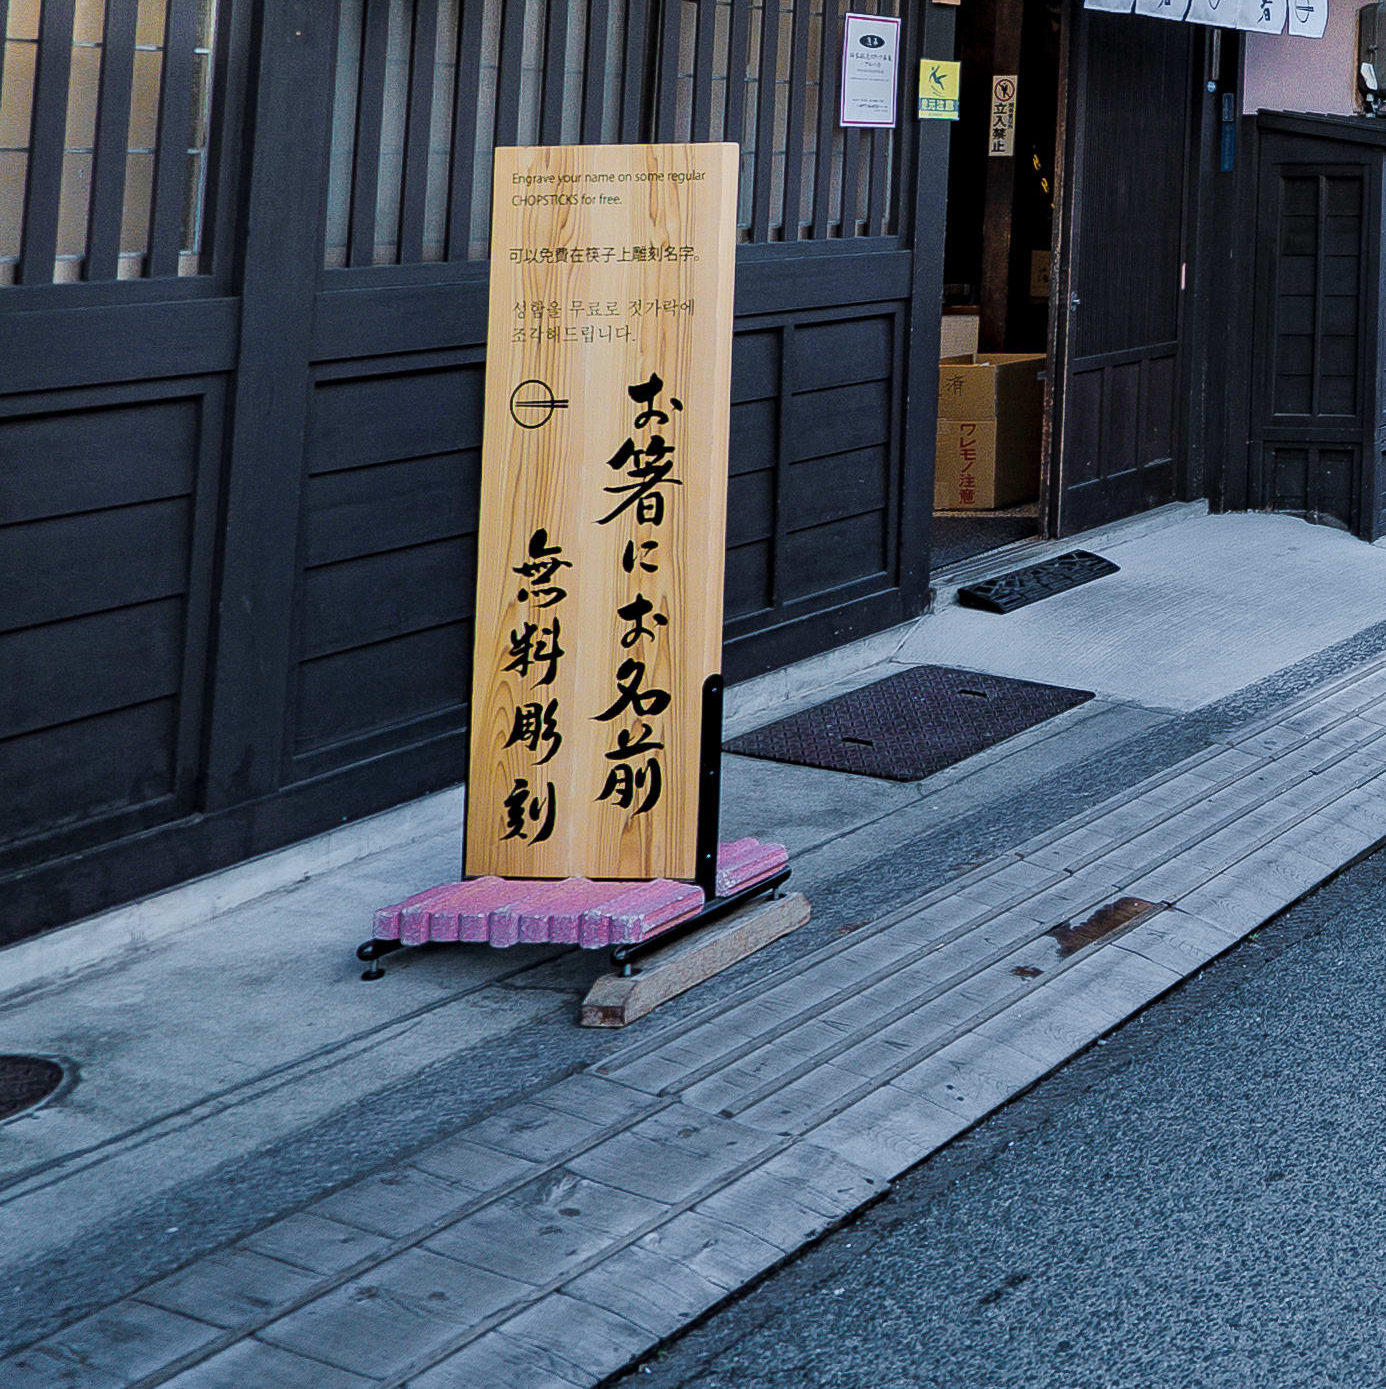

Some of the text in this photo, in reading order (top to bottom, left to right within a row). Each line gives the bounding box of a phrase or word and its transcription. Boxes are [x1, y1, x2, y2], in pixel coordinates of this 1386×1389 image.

[991, 101, 1007, 152] 立入禁止
[512, 170, 706, 186] Engrave your name on some regular
[512, 193, 622, 206] CHOPSTICKS for free.
[512, 298, 695, 318] 성함을 무료로 젓가락에
[511, 325, 637, 343] 조각해드립니다.
[959, 423, 977, 504] ワレモノ注意
[589, 372, 684, 818] お箸にお名前
[499, 528, 573, 847] 無料彫刻
